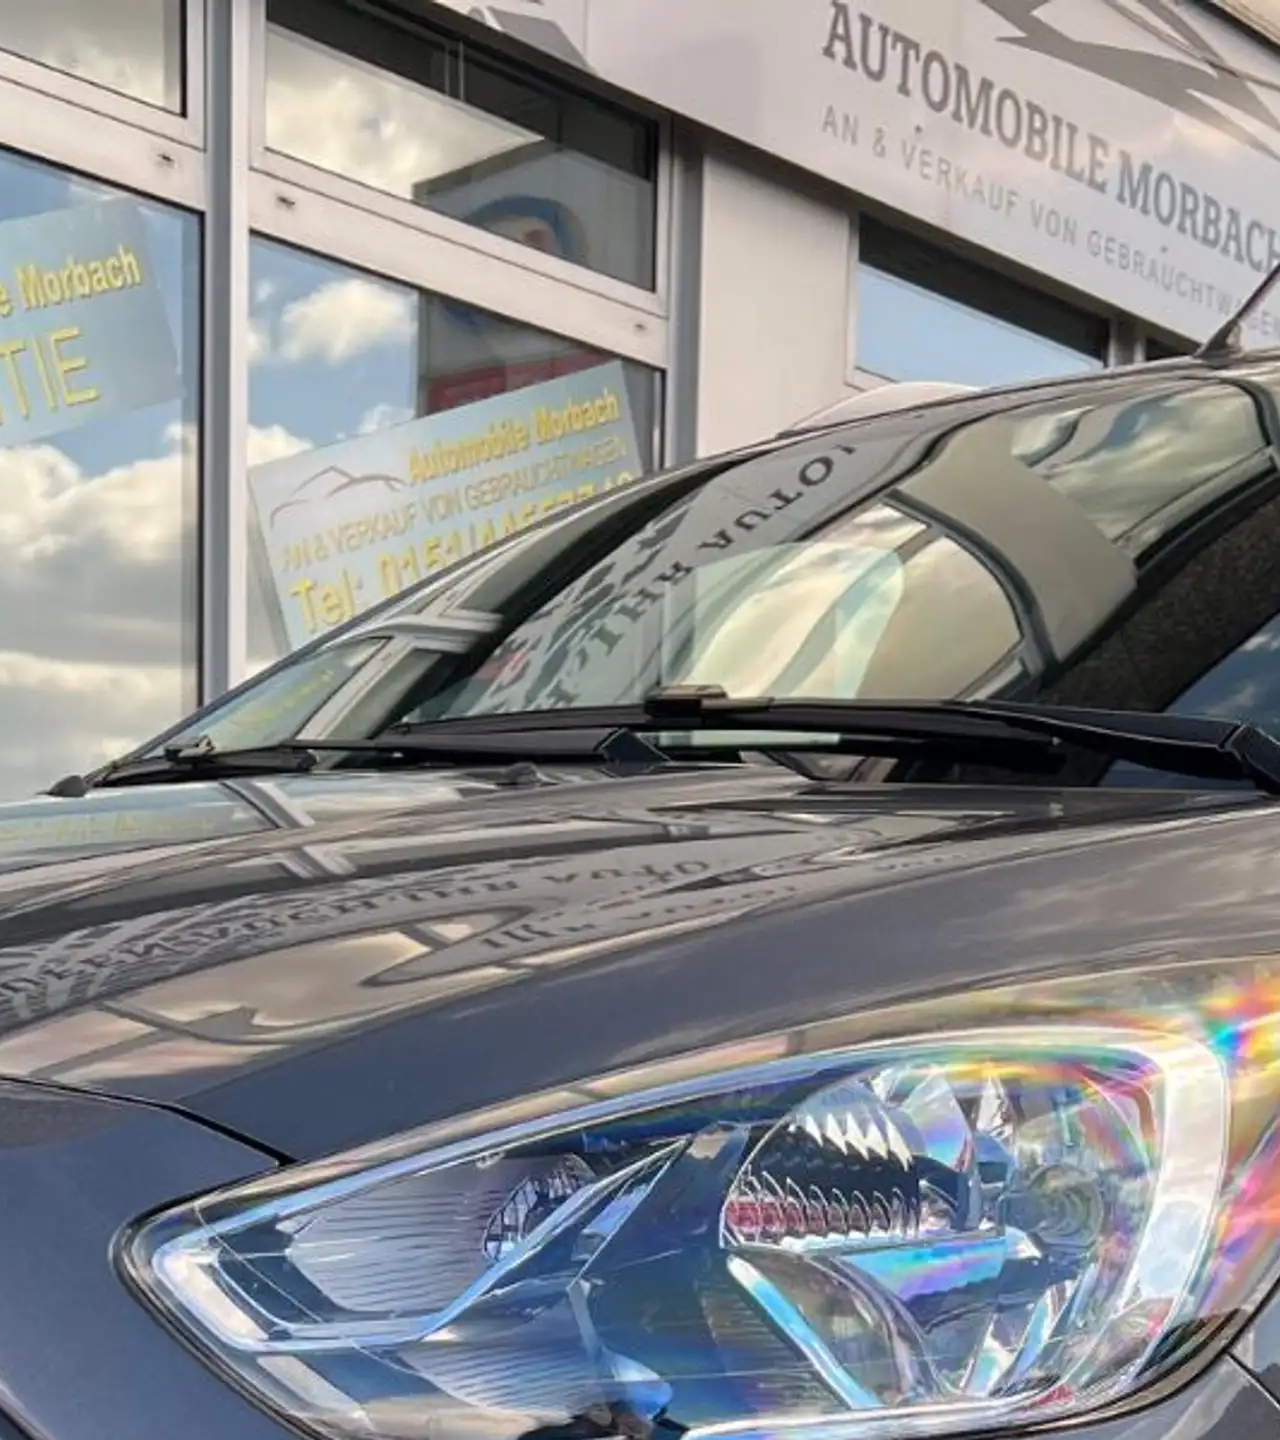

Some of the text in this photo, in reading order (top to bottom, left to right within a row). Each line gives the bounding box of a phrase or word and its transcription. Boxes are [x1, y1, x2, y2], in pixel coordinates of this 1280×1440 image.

[822, 0, 1110, 195] AUTOMOBILE
[821, 105, 859, 146] AN
[872, 126, 887, 159] &
[901, 138, 1021, 217] VERKAUF
[1029, 199, 1078, 248] VON
[18, 243, 142, 313] Morbach
[408, 387, 621, 486] Automobile Morbach
[423, 487, 464, 527] VON
